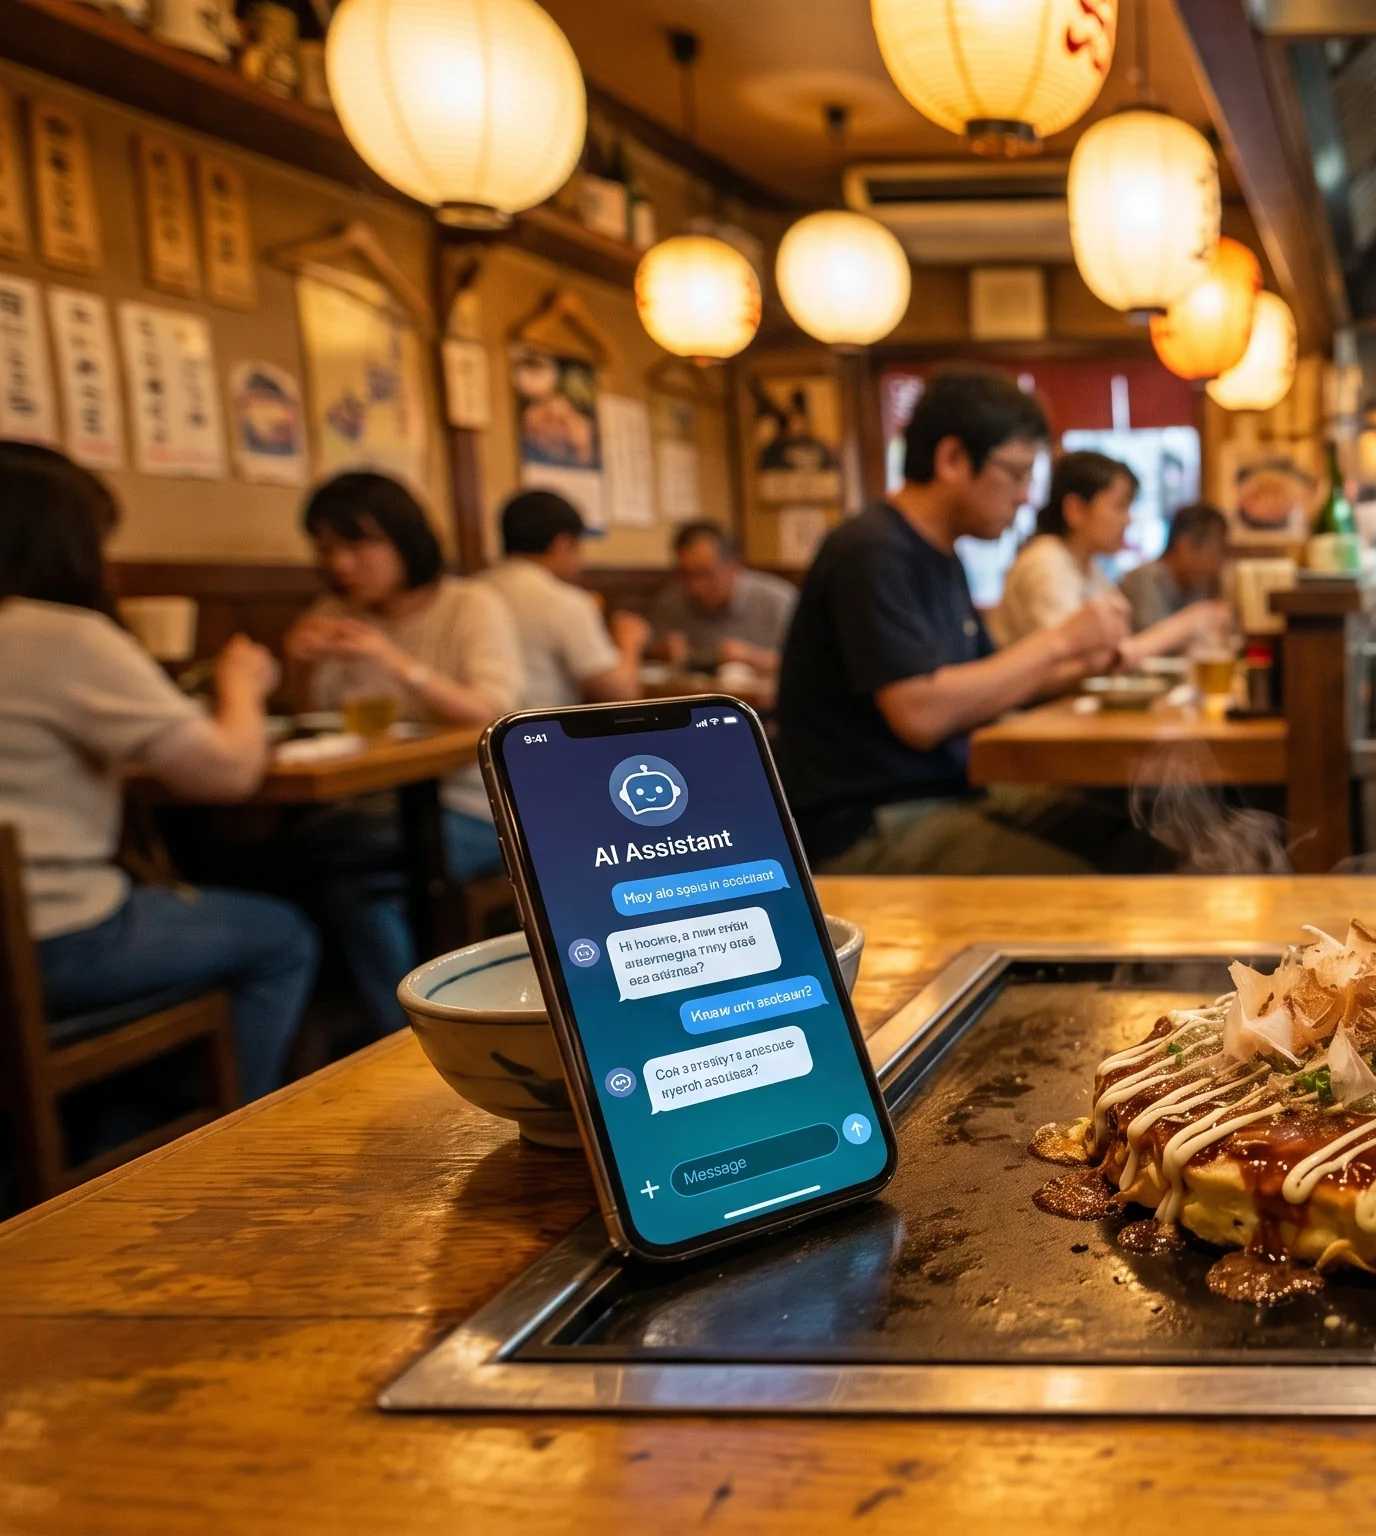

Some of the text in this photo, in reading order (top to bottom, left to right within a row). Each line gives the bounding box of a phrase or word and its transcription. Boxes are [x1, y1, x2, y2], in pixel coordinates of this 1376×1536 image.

[523, 733, 548, 744] 9:41
[595, 829, 733, 867] AI Assistant
[619, 941, 633, 952] Hi
[683, 1158, 747, 1185] Message
